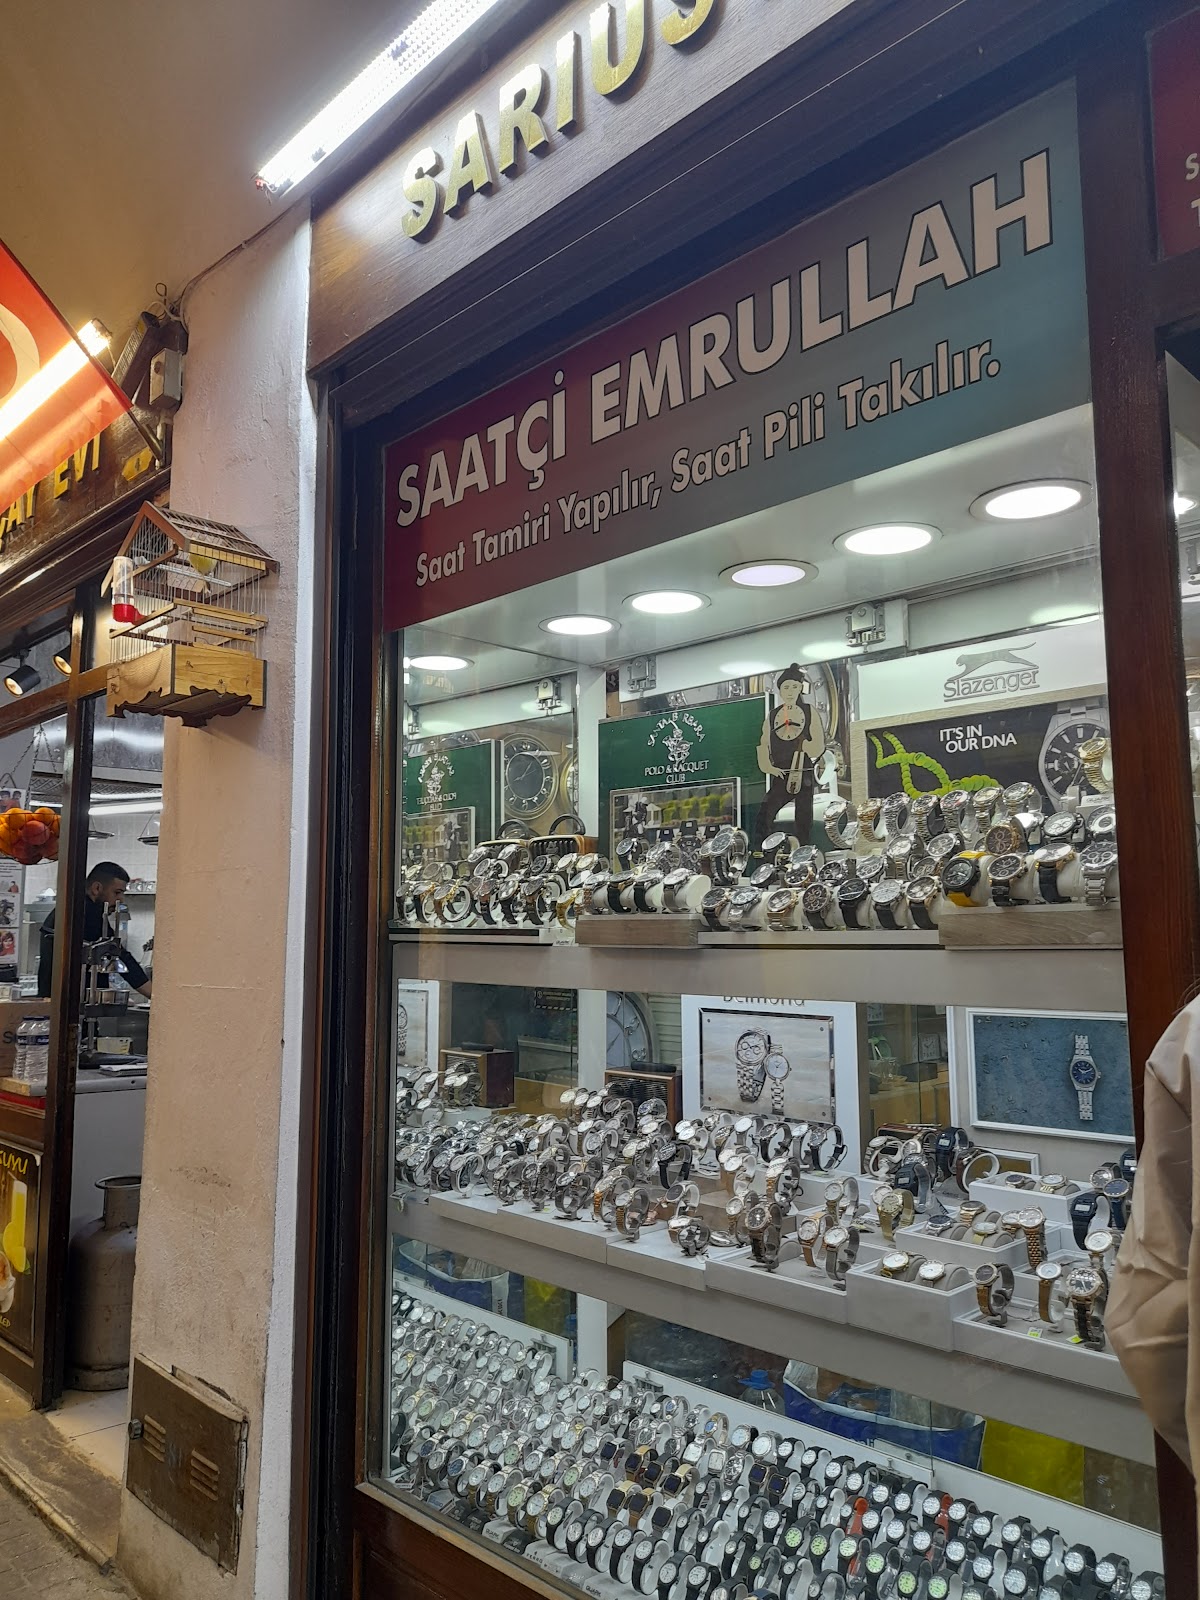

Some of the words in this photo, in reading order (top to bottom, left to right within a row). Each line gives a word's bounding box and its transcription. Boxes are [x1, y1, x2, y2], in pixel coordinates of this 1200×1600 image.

[396, 369, 567, 528] SAATÇİ
[591, 148, 1053, 444] EMRULLAH
[416, 541, 466, 587] Saat
[473, 502, 551, 566] Tamiri
[670, 427, 752, 493] Saat
[763, 392, 826, 460] Pili
[943, 669, 1040, 698] Slazenger
[939, 726, 964, 741] IT'S
[966, 724, 983, 738] IN
[945, 737, 979, 753] OUR
[981, 732, 1018, 749] DNA
[644, 765, 665, 776] POLO
[672, 760, 710, 773] RACQUET
[666, 773, 686, 784] CLUB
